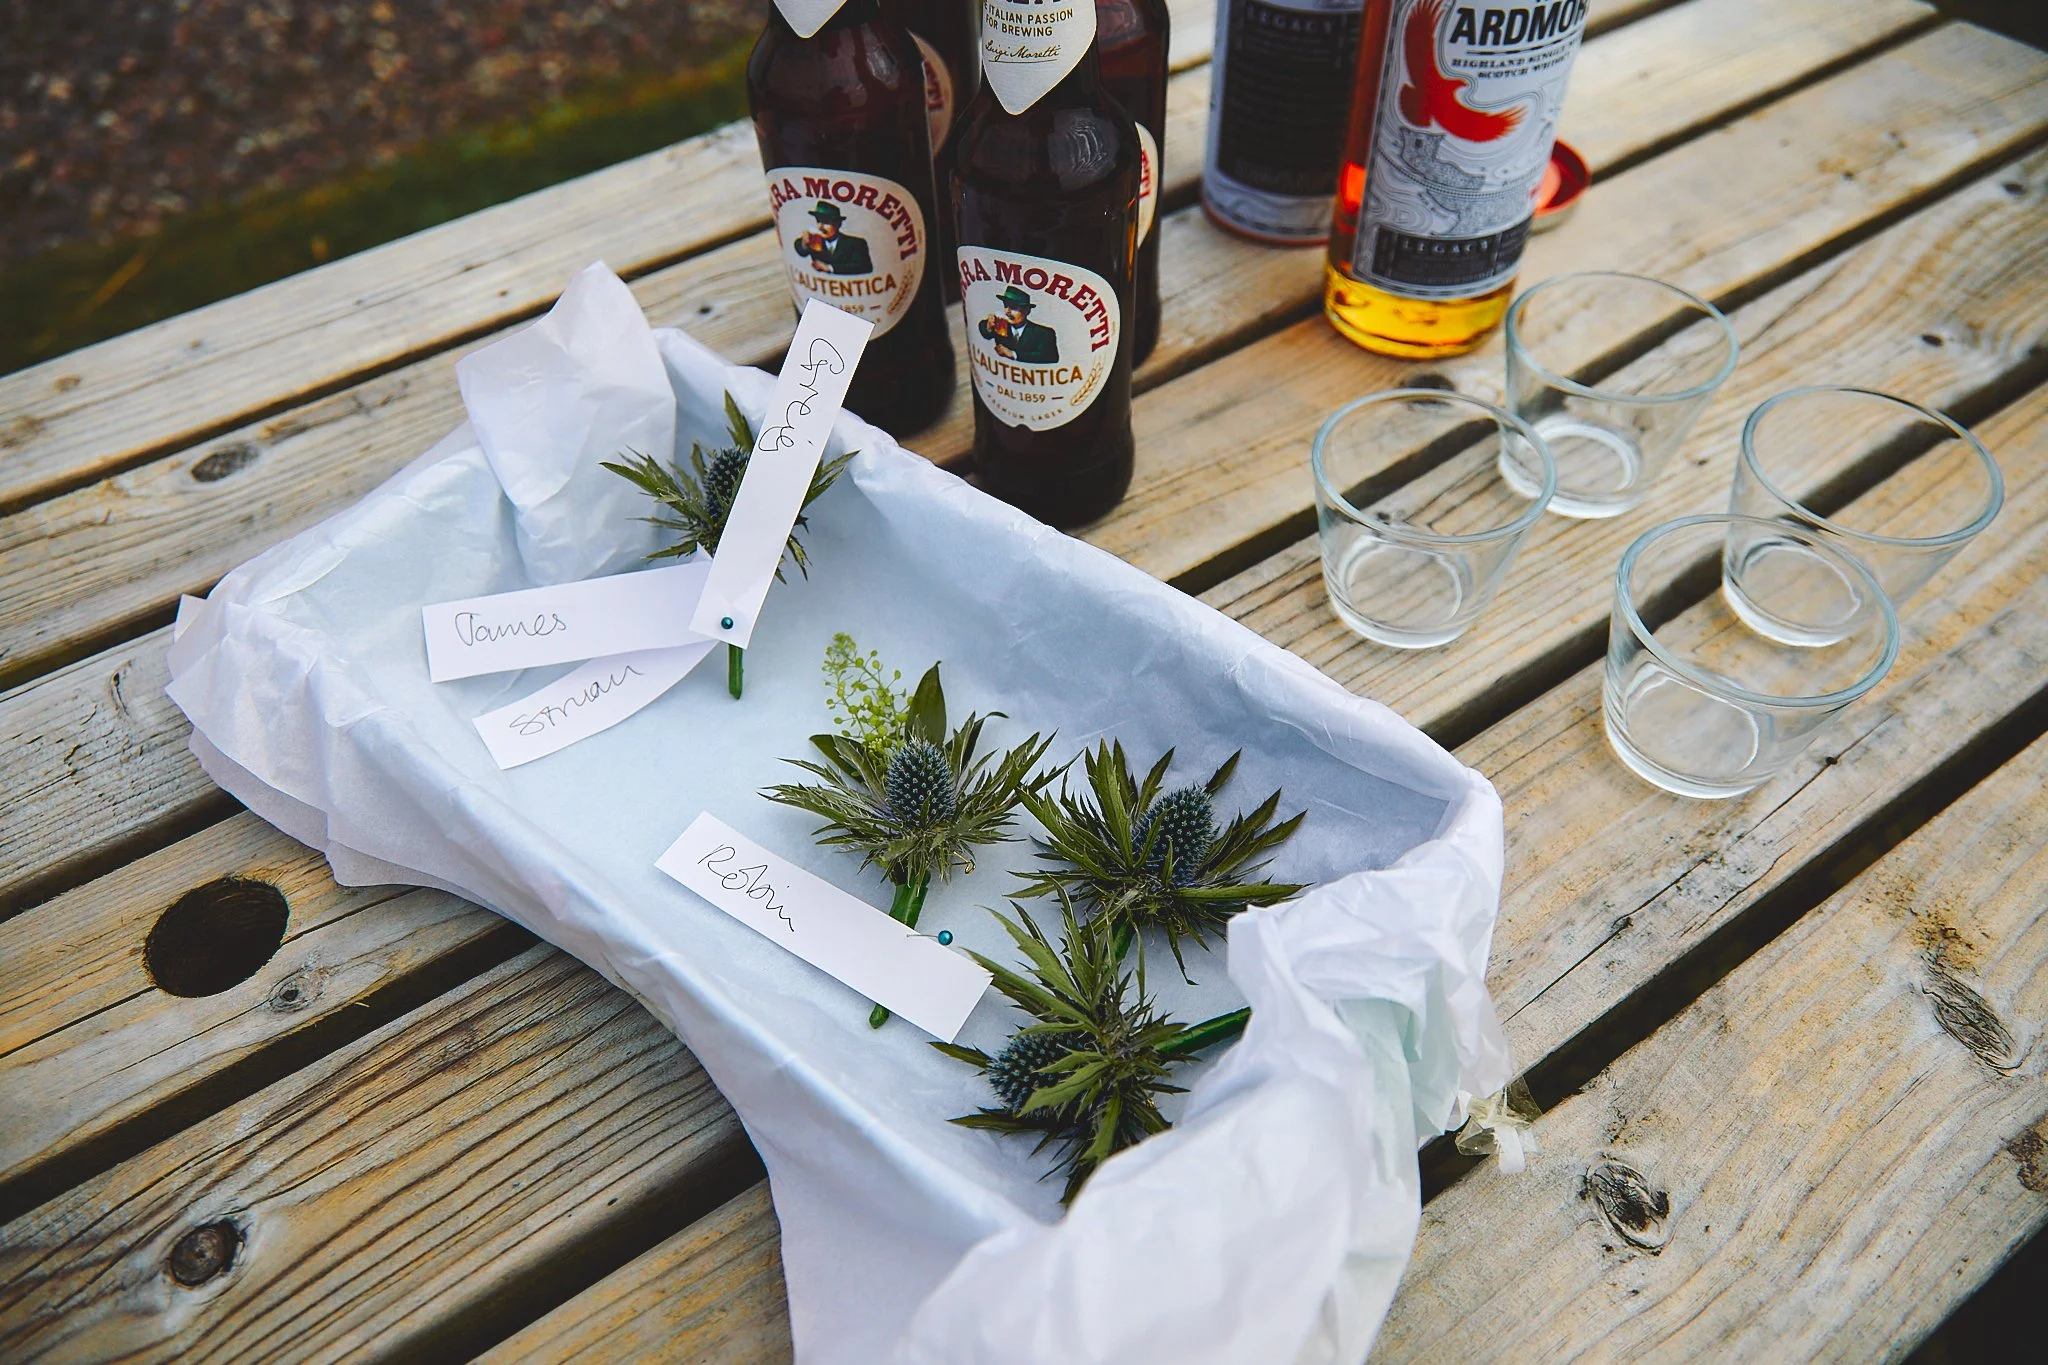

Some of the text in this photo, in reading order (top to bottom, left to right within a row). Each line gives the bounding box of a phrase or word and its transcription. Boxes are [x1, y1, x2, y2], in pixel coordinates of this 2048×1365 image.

[986, 14, 1053, 37] FOR BREWING
[988, 6, 1073, 25] ITALIAN PASSION
[1451, 58, 1525, 68] HIGHLAND
[803, 177, 918, 261] MORETTI
[1402, 238, 1489, 254] LEGACY
[994, 259, 1110, 352] MORETTI
[972, 344, 1083, 386] L'AUTENTICA
[997, 384, 1046, 403] DAL 1859
[454, 612, 567, 646] James
[698, 844, 795, 932] Robin
